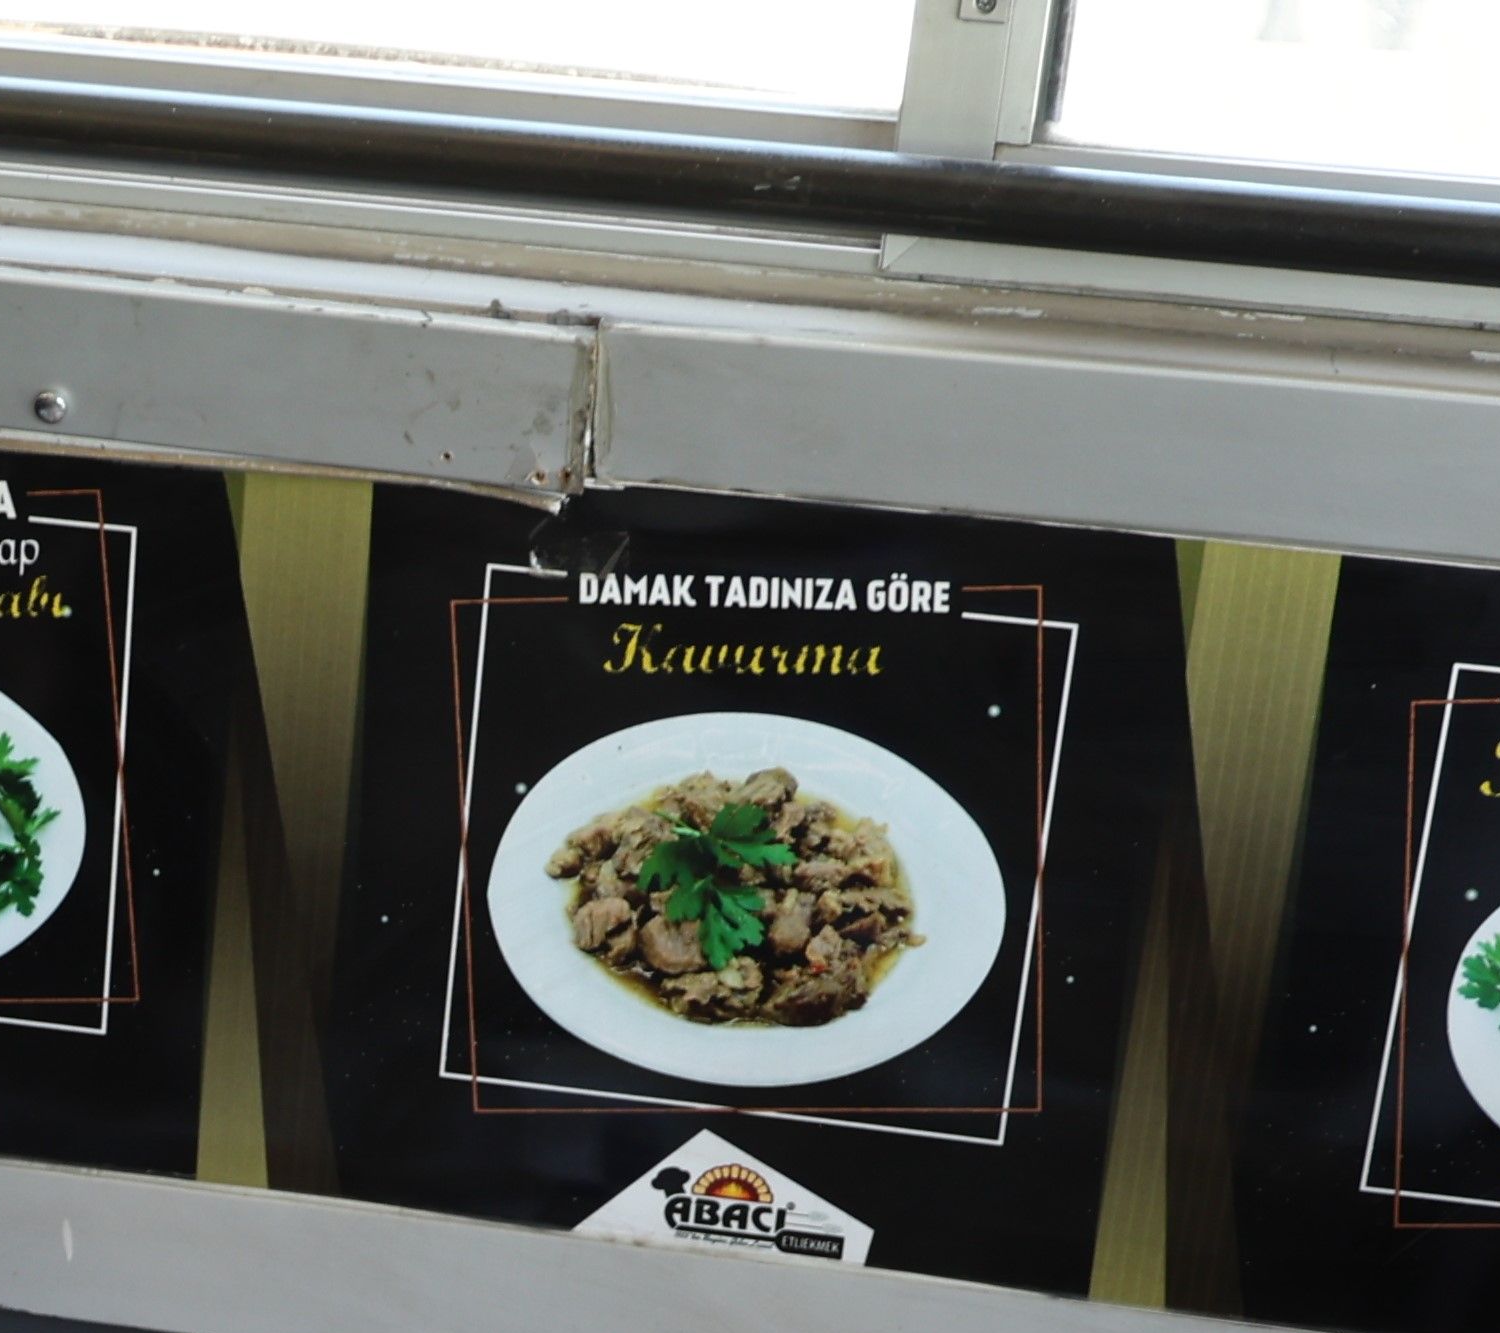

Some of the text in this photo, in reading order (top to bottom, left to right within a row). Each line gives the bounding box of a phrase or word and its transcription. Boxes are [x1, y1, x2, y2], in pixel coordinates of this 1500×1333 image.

[579, 572, 951, 614] DAMAK TADINIZA GÖRE
[602, 622, 884, 677] Kavurma
[664, 1196, 787, 1232] ABACI
